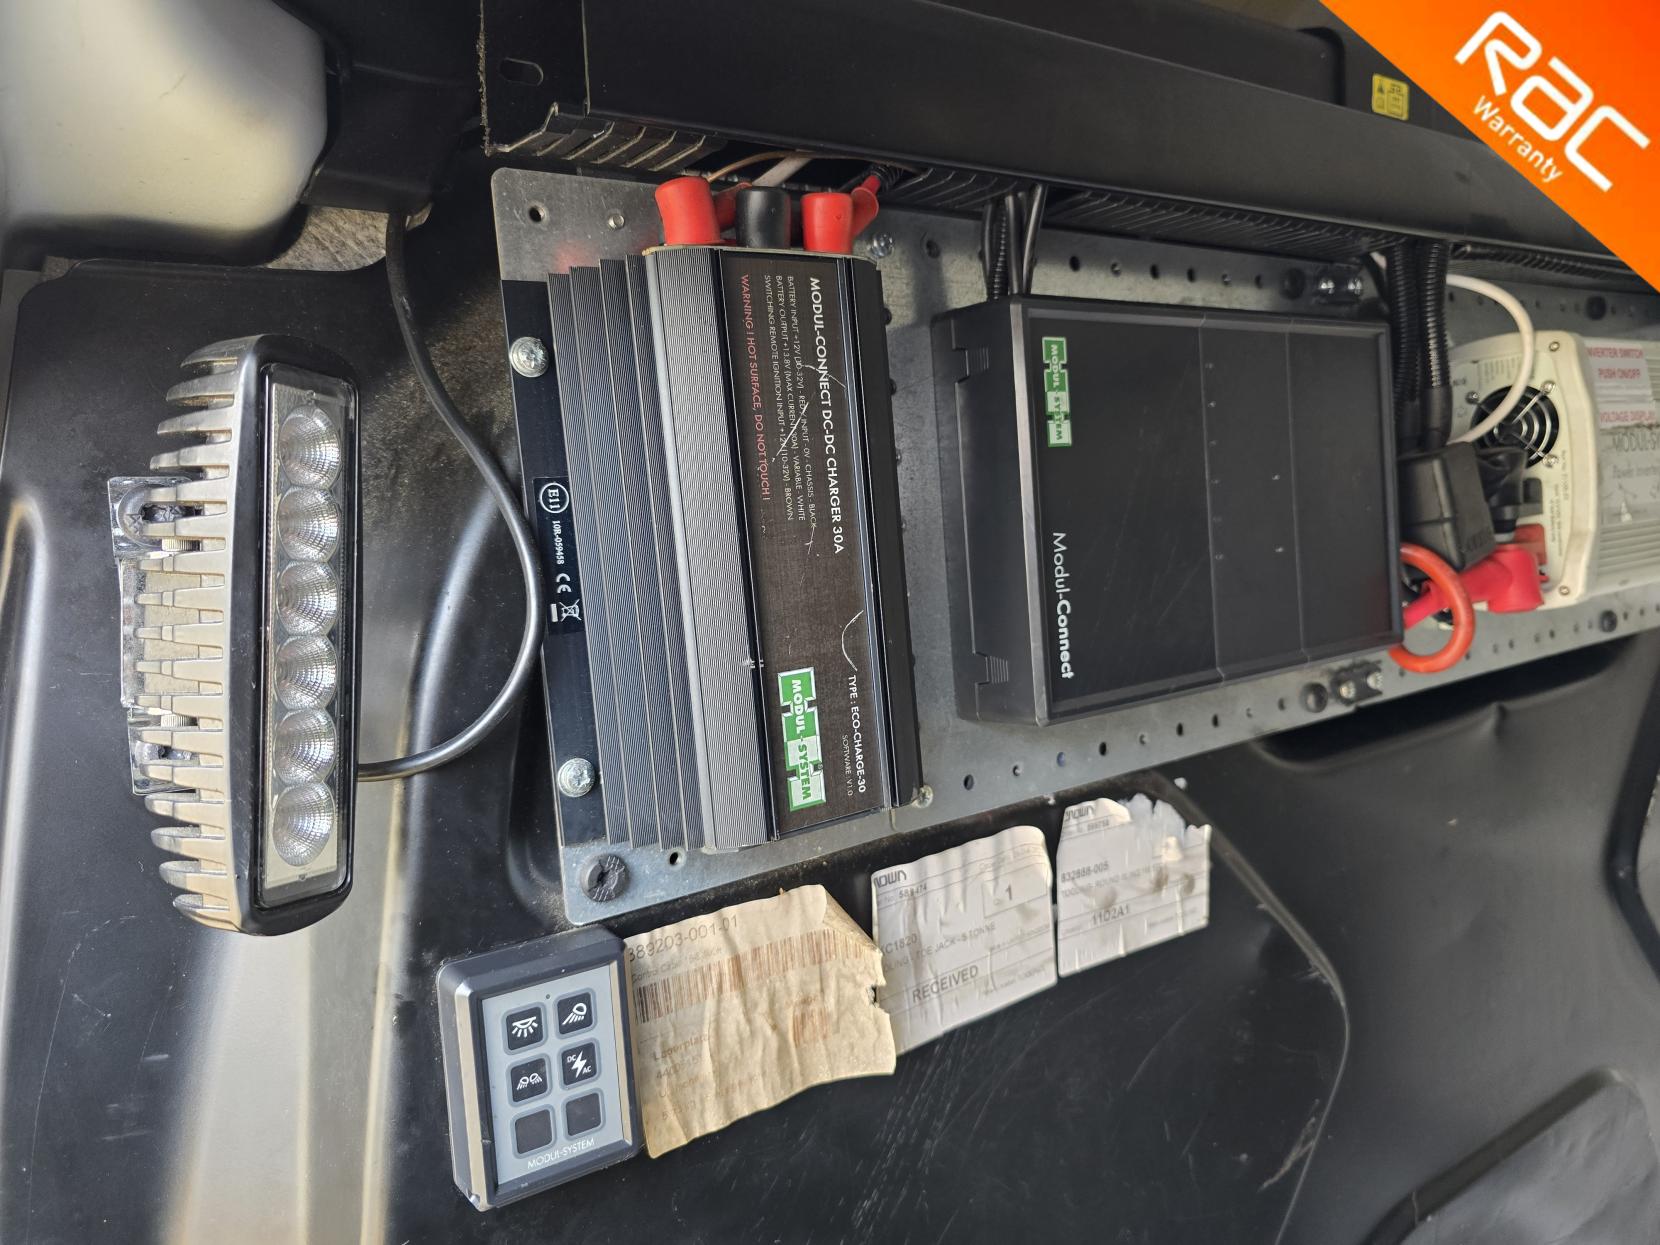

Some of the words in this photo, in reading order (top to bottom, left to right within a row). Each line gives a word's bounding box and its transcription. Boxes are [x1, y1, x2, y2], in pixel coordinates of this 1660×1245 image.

[740, 275, 754, 329] WARNING
[764, 275, 776, 324] SWITCHING
[776, 276, 784, 307] BATTERY
[787, 276, 796, 307] BATTERY
[780, 309, 788, 341] OUTPUT
[790, 309, 799, 332] INPUT
[747, 338, 756, 360] HOT
[769, 326, 778, 360] REMOTE
[810, 277, 831, 406] MODUL-CONNECT
[749, 362, 762, 411] SURFACE,
[773, 362, 782, 400] IGNITION
[754, 415, 763, 431] DO
[776, 402, 785, 426] INPUT
[788, 393, 798, 430] CURRENT
[756, 434, 766, 456] NOT
[800, 419, 810, 442] INPUT
[822, 410, 835, 454] DC-DC
[759, 459, 770, 494] TOUCH
[793, 456, 802, 490] VARIABLE
[547, 488, 560, 509] E11
[784, 488, 793, 520] BROWN
[826, 458, 841, 522] CHARGER
[797, 495, 805, 521] WHITE
[808, 504, 816, 528] BLACK
[552, 520, 564, 565] 10R-059458
[833, 526, 844, 554] 30A
[1053, 532, 1074, 679] Modul-Connect
[848, 675, 858, 698] TYPE
[842, 735, 851, 774] SOFTWARE
[851, 706, 866, 792] ECO-CHARGE-30
[1005, 884, 1013, 900] 1
[912, 965, 979, 1003] RECEIVED
[566, 1054, 576, 1063] DC
[582, 1065, 592, 1074] AC
